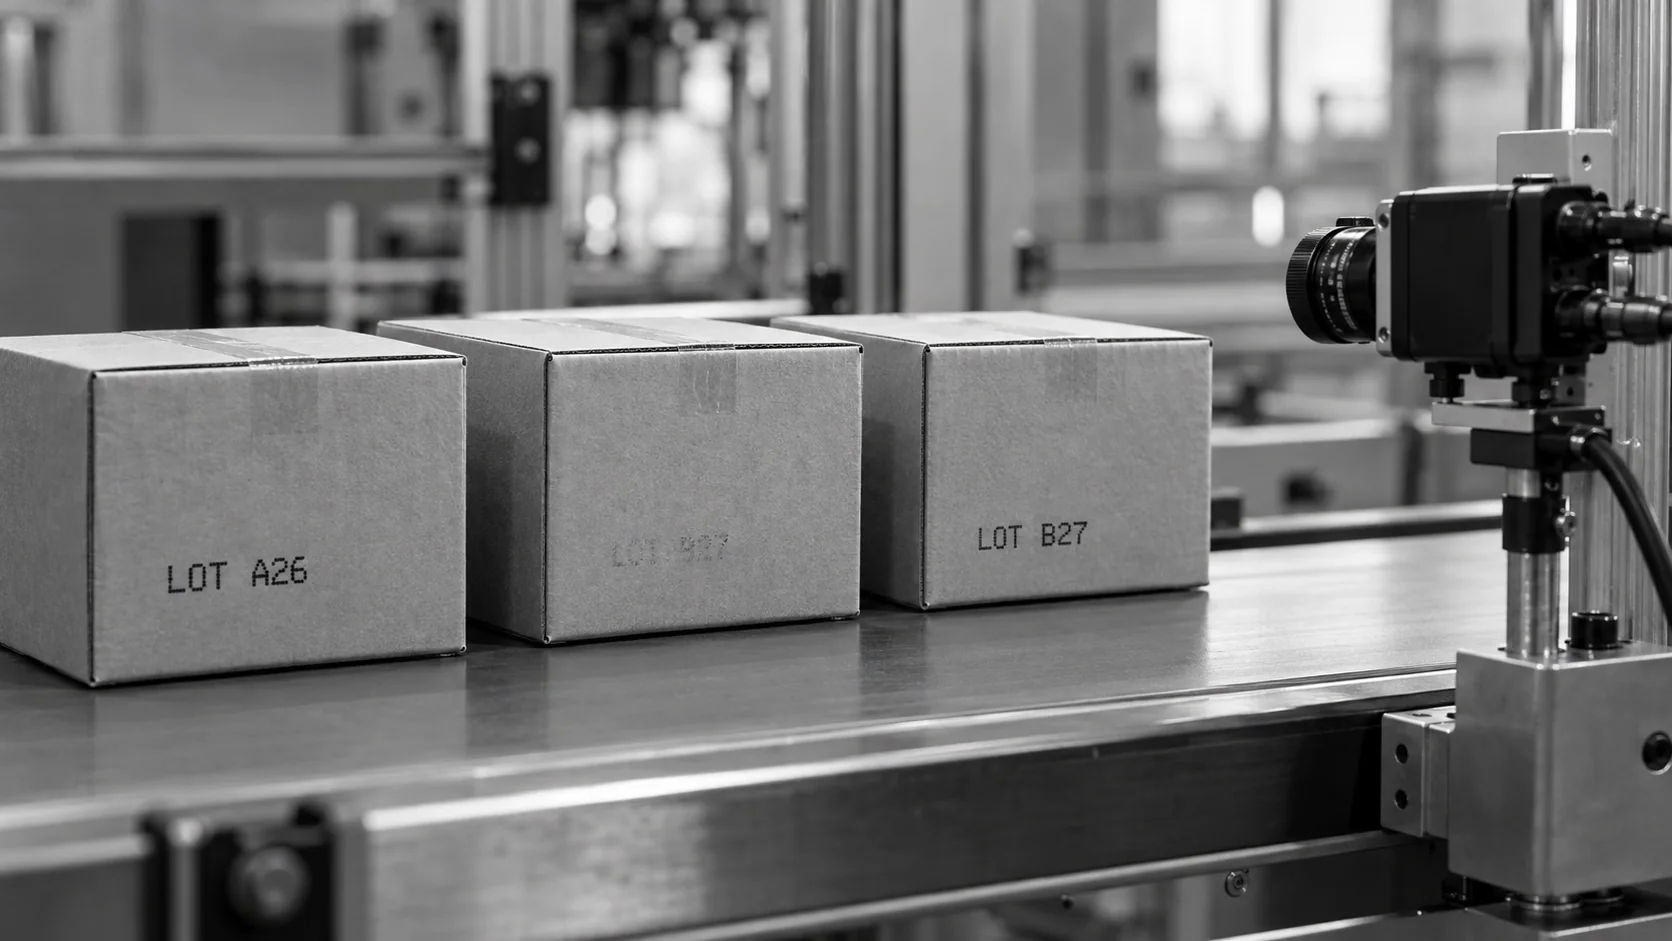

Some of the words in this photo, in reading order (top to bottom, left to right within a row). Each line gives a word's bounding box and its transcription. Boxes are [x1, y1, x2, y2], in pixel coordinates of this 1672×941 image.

[978, 524, 1023, 551] LOT
[1041, 520, 1088, 547] B27
[167, 561, 228, 595] LOT
[251, 555, 308, 588] A26
